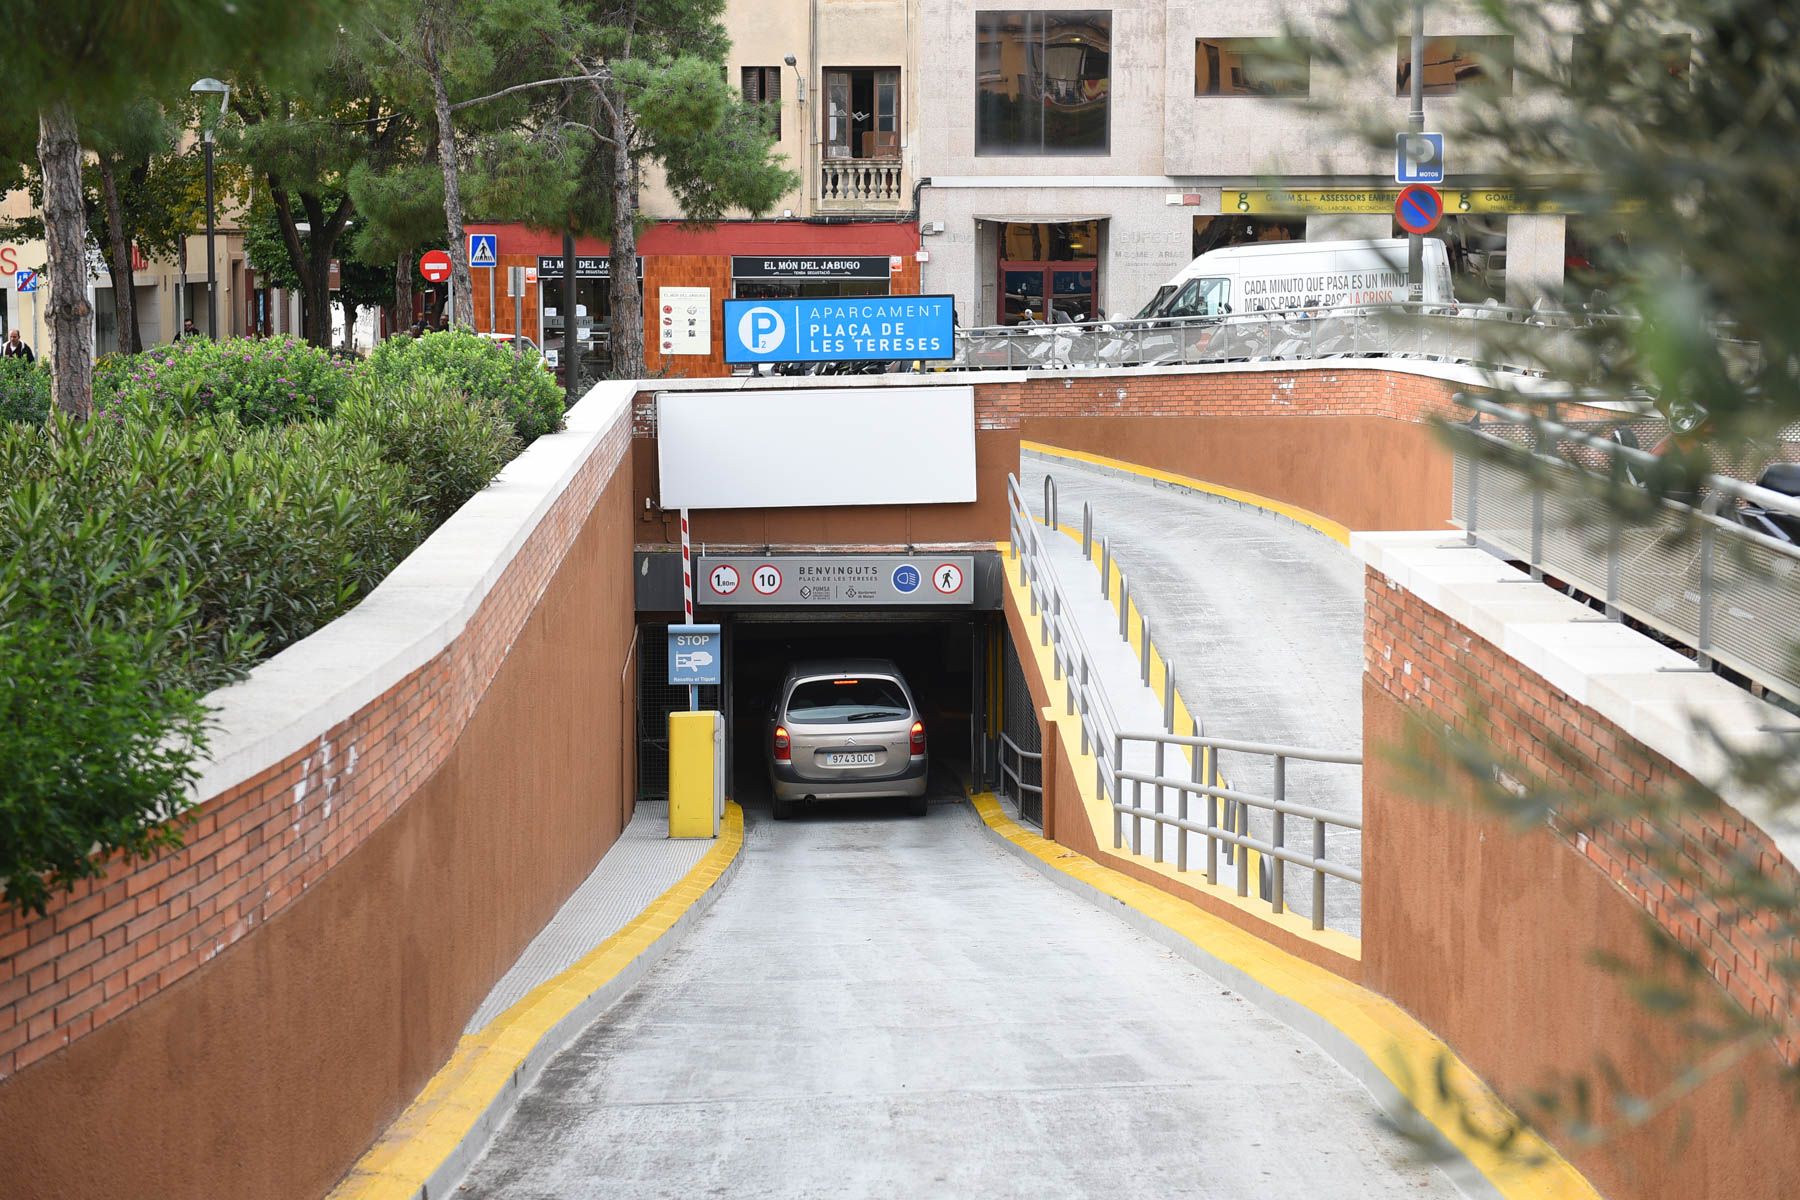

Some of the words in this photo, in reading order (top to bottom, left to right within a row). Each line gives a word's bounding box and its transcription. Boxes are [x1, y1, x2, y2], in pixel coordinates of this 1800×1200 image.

[1405, 138, 1435, 178] P
[1319, 193, 1366, 202] ASSESSORS
[542, 260, 555, 269] EL
[578, 260, 597, 269] DEL
[764, 261, 776, 270] EL
[778, 259, 799, 270] MÓN
[800, 261, 819, 270] DEL
[820, 261, 860, 270] JABUGO
[1244, 280, 1267, 296] CADA
[1269, 277, 1304, 294] MINUTO
[1306, 276, 1324, 293] QUE
[1326, 275, 1349, 291] PASA
[1351, 274, 1363, 290] ES
[1365, 273, 1378, 289] UN
[1380, 272, 1409, 288] MINUT
[1244, 297, 1276, 312] MENOS
[1278, 295, 1302, 311] PARA
[1362, 290, 1393, 305] CRISIS
[810, 304, 942, 319] APARCAMENT
[751, 312, 778, 349] P
[810, 323, 872, 340] PLAÇA
[881, 322, 905, 336] DE
[810, 339, 845, 353] LES
[855, 337, 941, 352] TERESES
[799, 566, 878, 575] BENVINGUTS
[759, 574, 775, 587] 10
[677, 635, 710, 646] STOP
